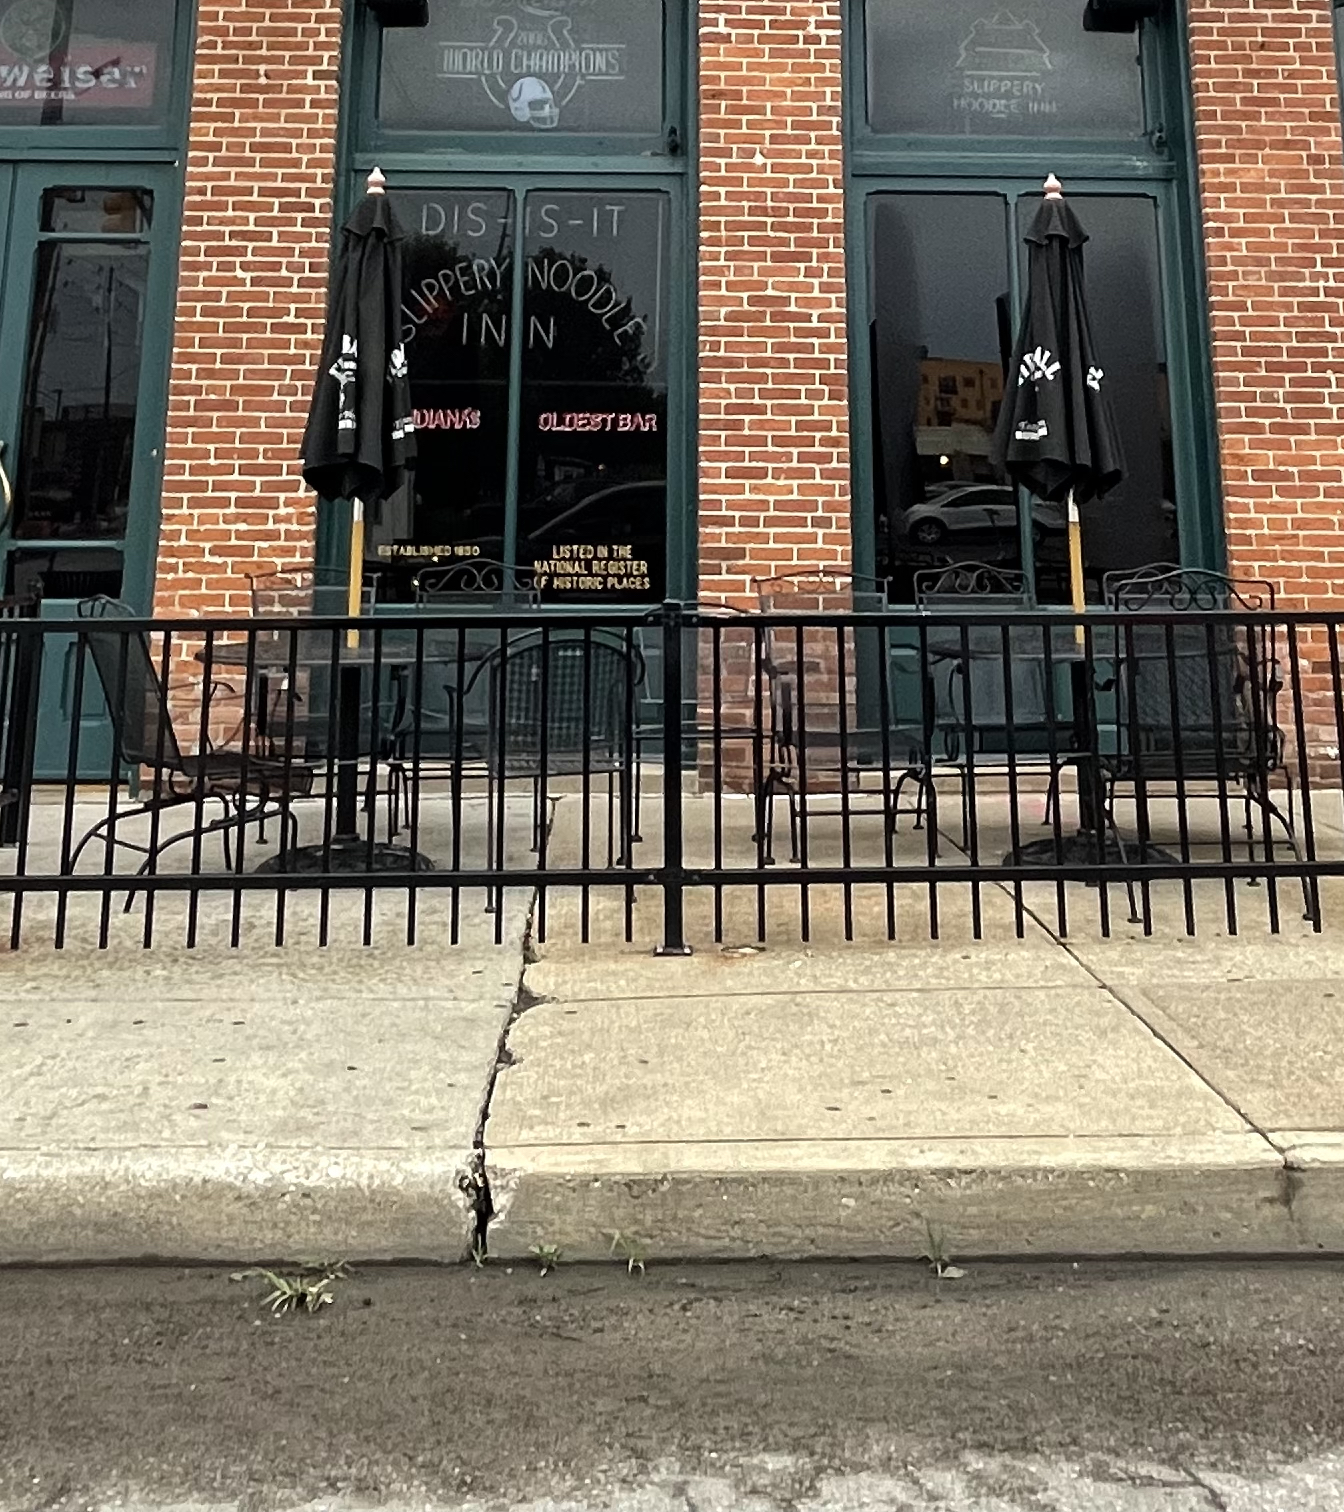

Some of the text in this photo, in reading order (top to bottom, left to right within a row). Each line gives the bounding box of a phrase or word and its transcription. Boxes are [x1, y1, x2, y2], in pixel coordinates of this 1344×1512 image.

[442, 48, 620, 75] WORLD CHAMPIONS
[421, 202, 625, 238] DIS-IS-IT
[527, 257, 648, 346] NOODLE
[617, 412, 657, 431] BAR
[552, 545, 594, 559] LISTED
[534, 560, 648, 575] NATIONAL REGISTER
[552, 576, 604, 590] HISTORIC
[607, 576, 650, 590] PLACES
